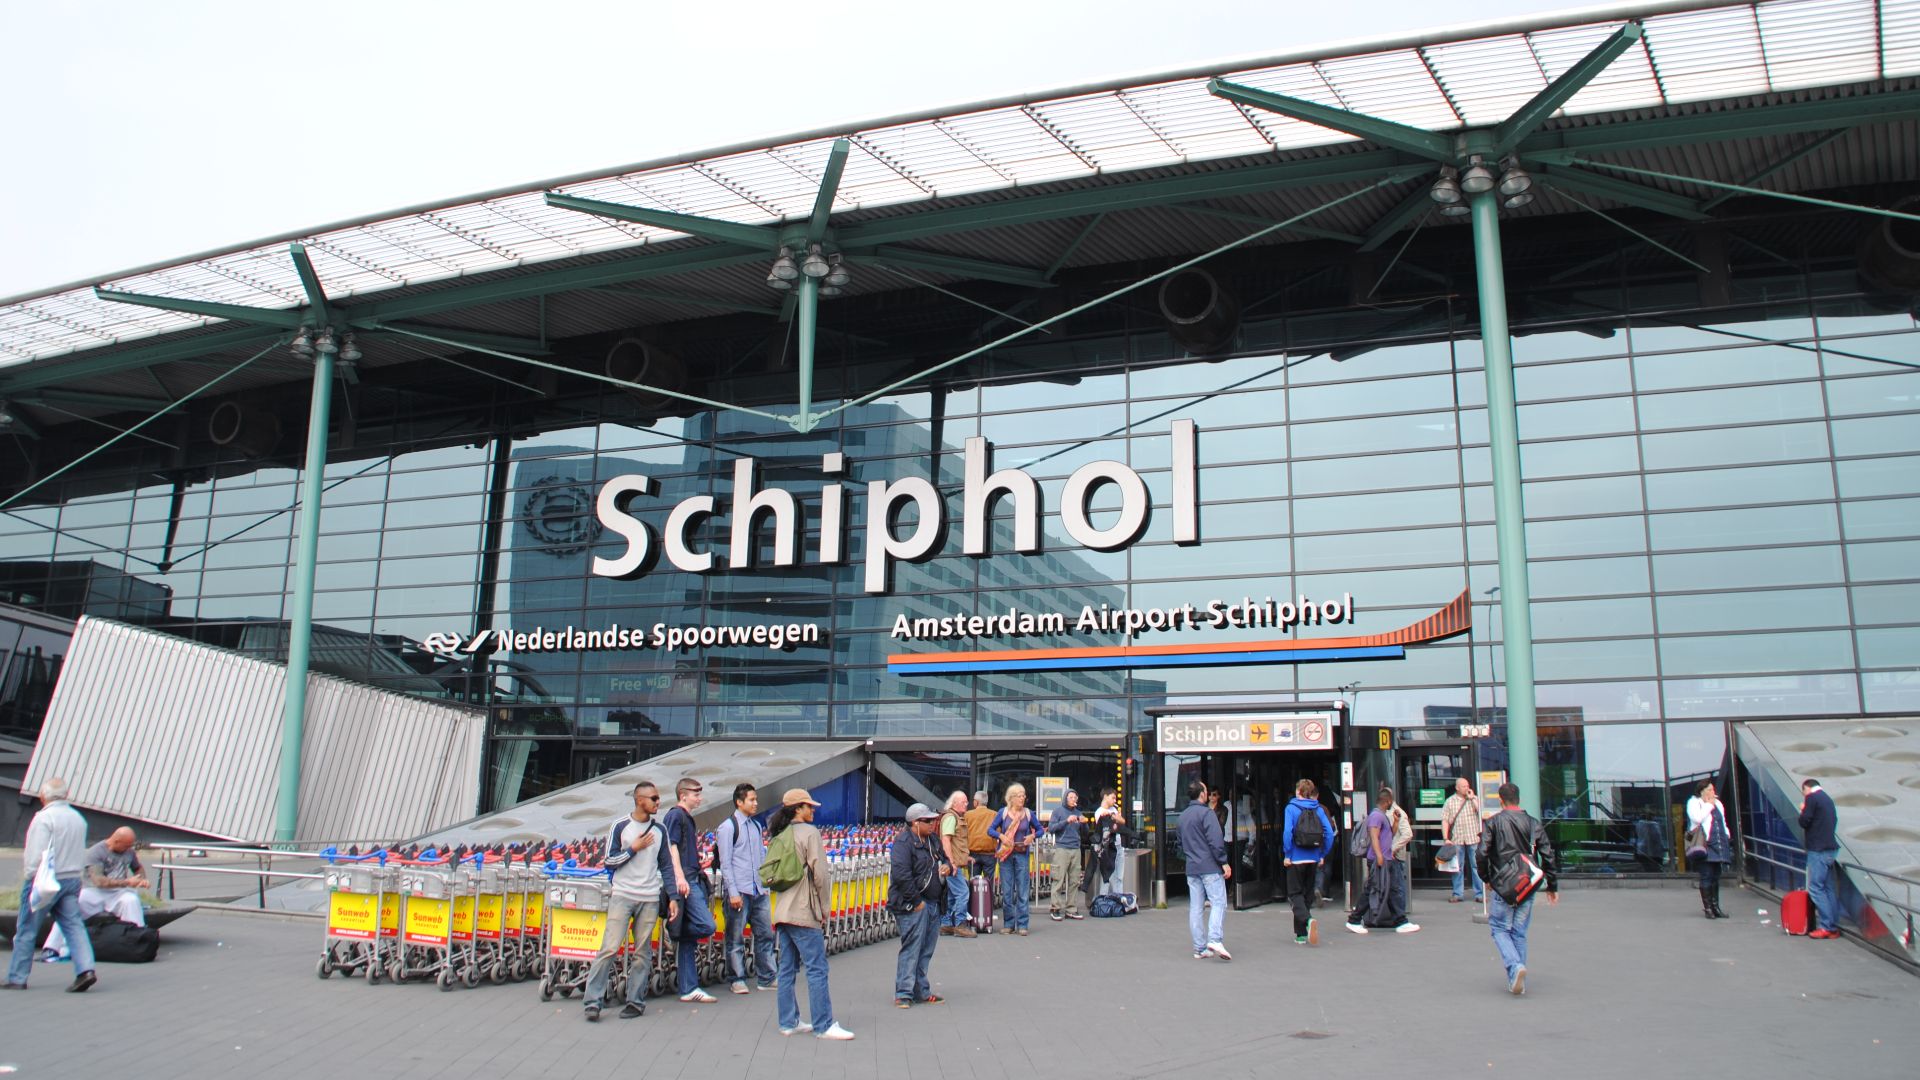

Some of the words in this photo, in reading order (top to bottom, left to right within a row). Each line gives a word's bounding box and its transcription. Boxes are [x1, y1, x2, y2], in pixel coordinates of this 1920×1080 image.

[592, 419, 1202, 597] Schiphol
[890, 611, 1065, 639] Amsterdam
[1075, 604, 1195, 637] Airport
[1206, 592, 1354, 632] Schiphol
[498, 623, 645, 653] Nederlandse
[652, 622, 819, 652] Spoorwegen
[610, 677, 642, 691] Free
[1163, 723, 1246, 746] Schiphol
[337, 907, 370, 919] Sunweb
[413, 912, 443, 924] Sunweb
[560, 925, 598, 937] Sunweb
